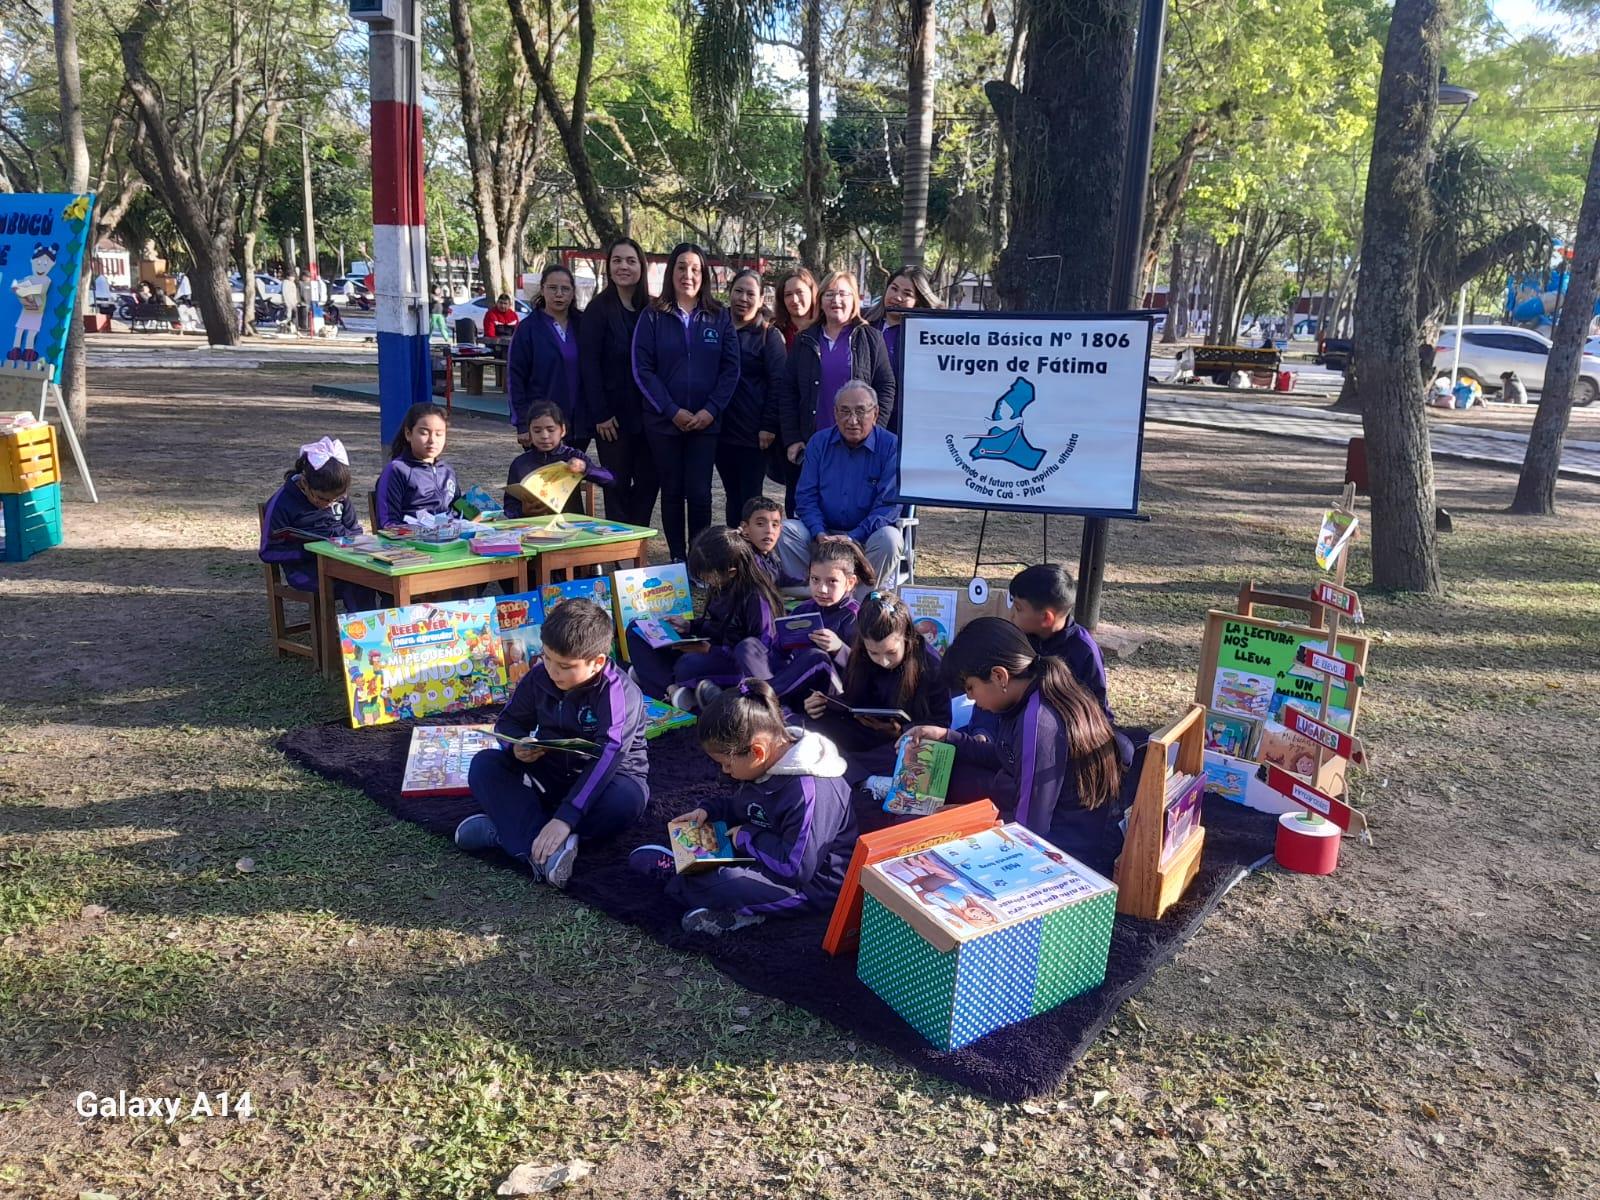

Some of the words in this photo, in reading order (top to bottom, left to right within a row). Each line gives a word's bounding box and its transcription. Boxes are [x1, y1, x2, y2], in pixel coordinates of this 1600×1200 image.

[919, 331, 981, 346] Escuela
[987, 331, 1043, 347] Básica
[1081, 332, 1130, 348] 1806
[937, 355, 999, 375] Virgen
[1006, 356, 1030, 373] de
[1037, 355, 1108, 374] Fátima
[945, 434, 979, 478] Construyendo
[979, 474, 988, 483] el
[988, 476, 1014, 489] futuro
[1015, 479, 1030, 488] con
[1057, 433, 1079, 465] altruista
[965, 477, 994, 497] Camba
[1022, 484, 1046, 498] Pilar
[1223, 634, 1249, 649] NOS
[1225, 622, 1241, 634] LA
[1244, 626, 1295, 646] LECTURA
[1234, 649, 1272, 666] LLEVA
[382, 659, 474, 688] MUNDO
[1276, 670, 1286, 679] A
[1295, 679, 1314, 692] UN
[1296, 714, 1337, 749] LUGARES
